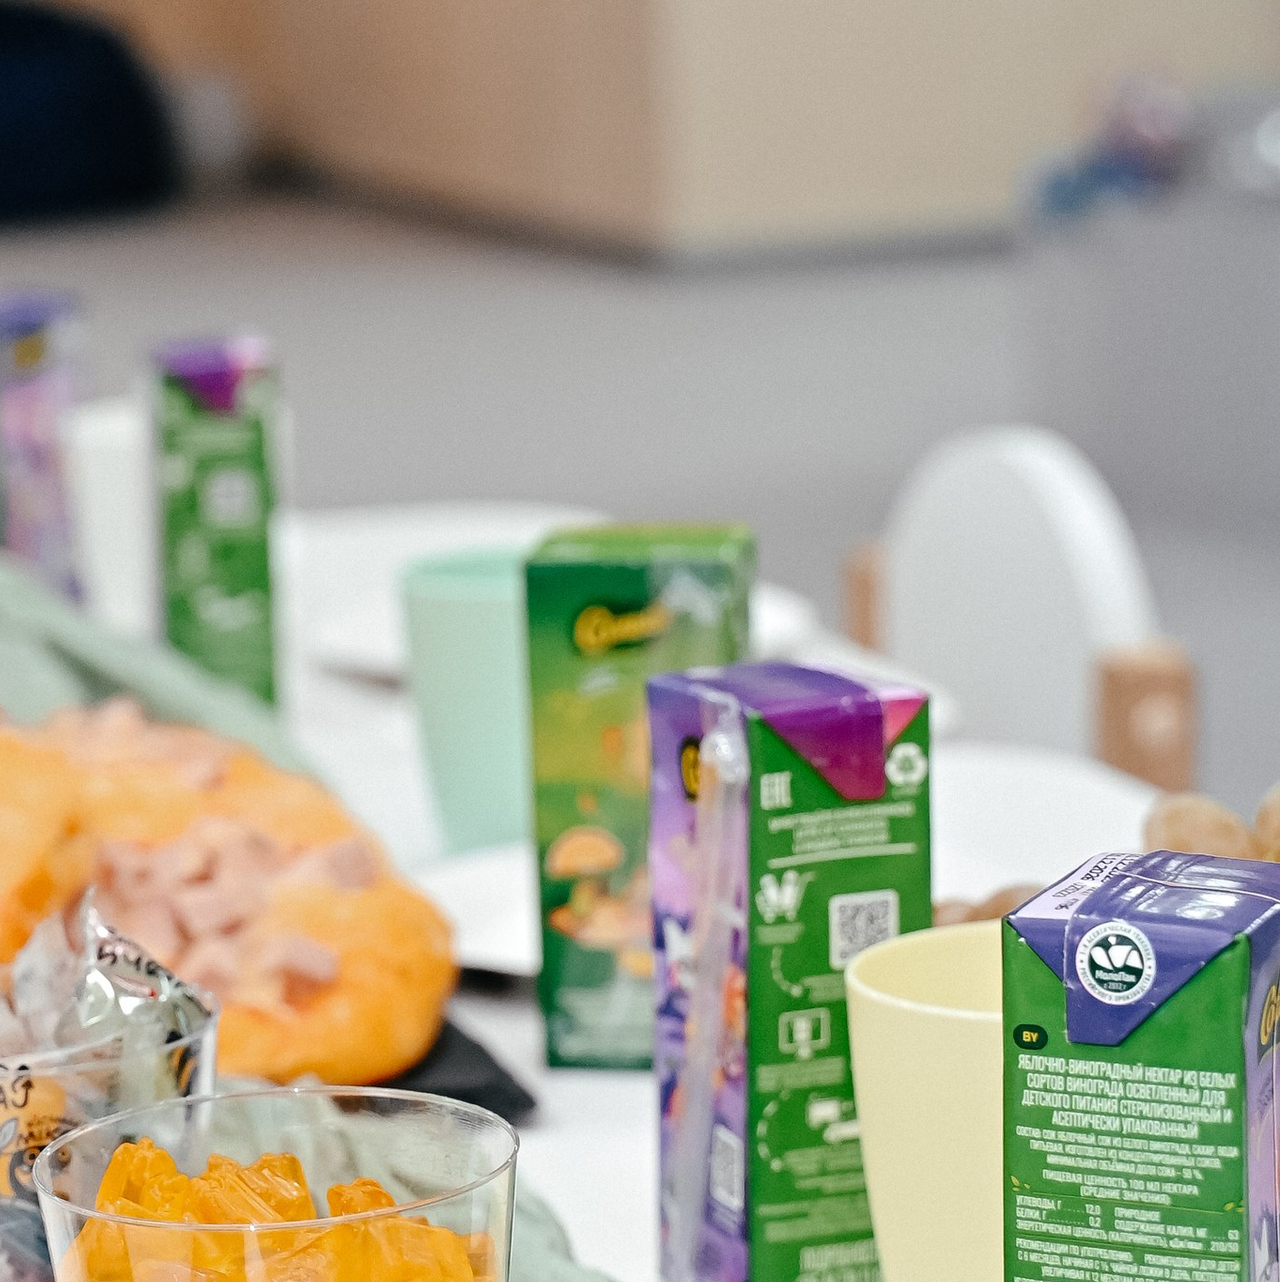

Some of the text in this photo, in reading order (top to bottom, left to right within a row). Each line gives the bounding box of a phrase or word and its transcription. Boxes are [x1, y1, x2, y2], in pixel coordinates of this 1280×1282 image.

[1022, 1030, 1038, 1042] BY
[1018, 1054, 1235, 1088] ЯБЛОЧНО-ВИНОГРАДНЫЙ НЕКТАР ИЗ БЕЛЫХ
[1026, 1072, 1226, 1107] СОРТОВ ВИНОГРАДА ОСВЕТЛЕННЫЙ ДЛЯ
[1022, 1089, 1232, 1123] ДЕТСКОГО ПИТАНИЯ СТЕРИЛИЗОВАННЫЙ И
[1052, 1110, 1198, 1139] АСЕПТИЧЕСКИ УПАКОВАННЫЙ
[1043, 1169, 1198, 1195] ПИЩЕВАЯ ЦЕННОСТЬ 100 МЛ НЕКТАРА
